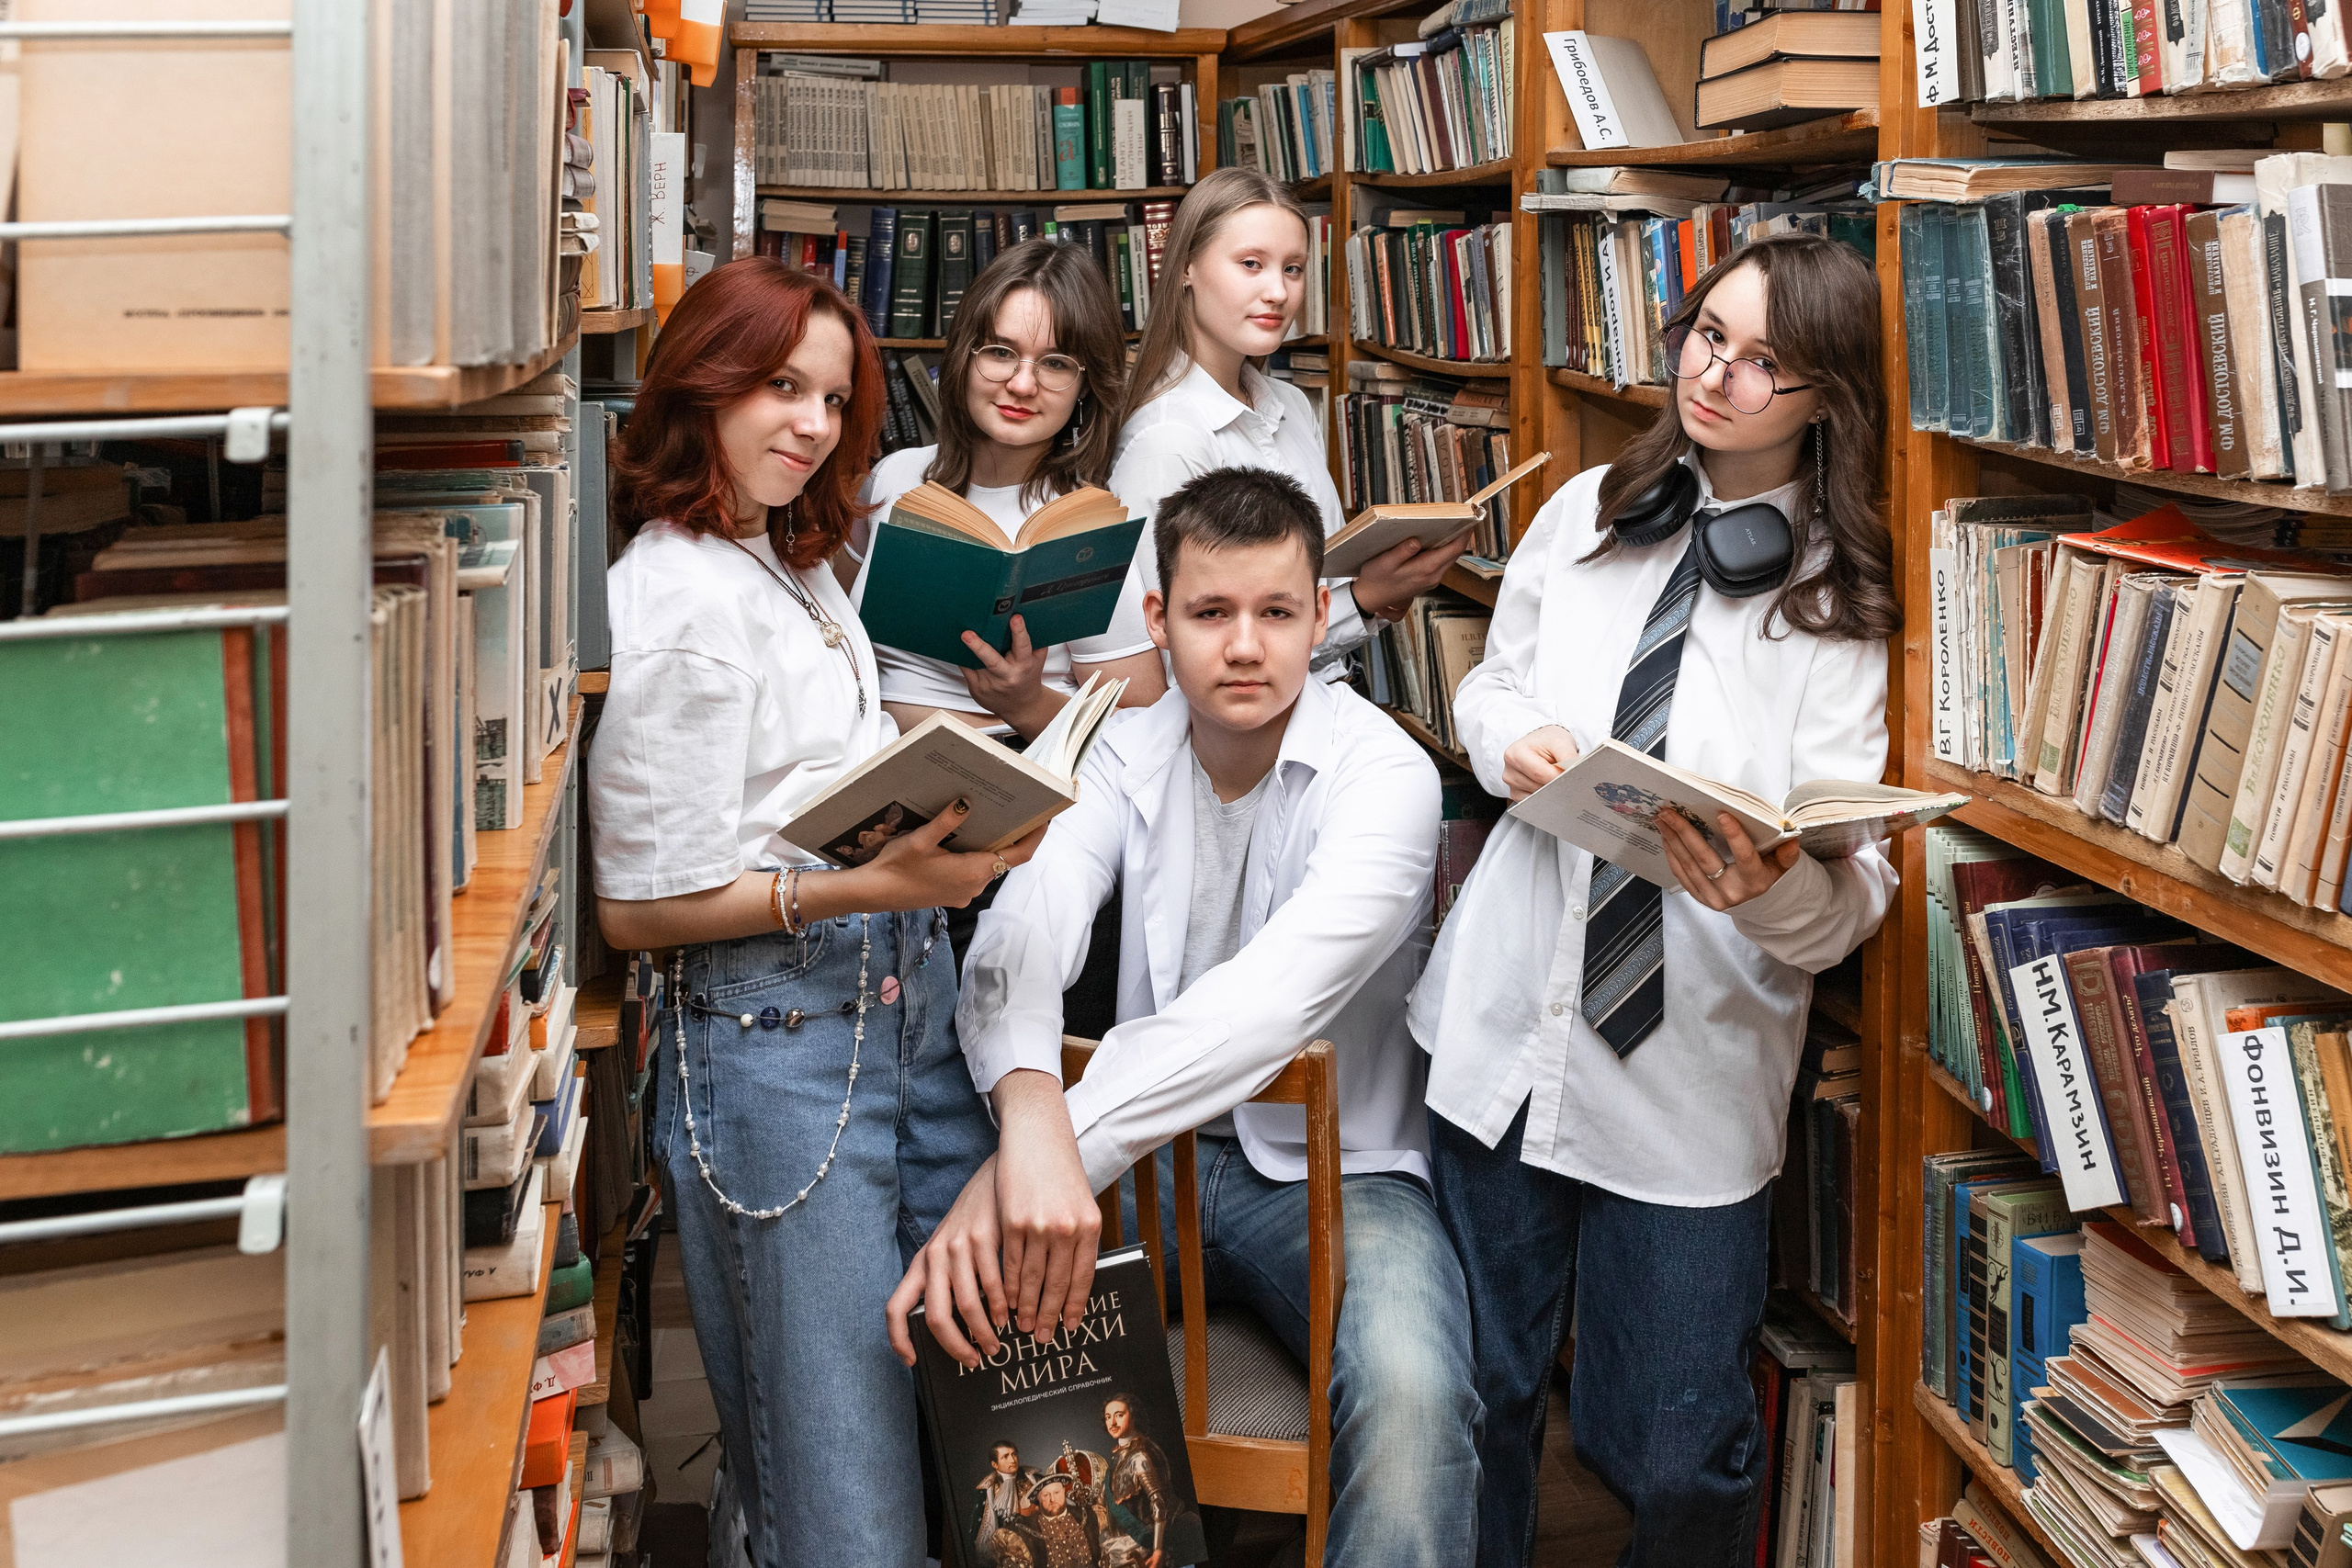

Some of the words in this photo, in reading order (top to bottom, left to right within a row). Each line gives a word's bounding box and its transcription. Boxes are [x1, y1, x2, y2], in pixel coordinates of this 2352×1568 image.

[2007, 0, 2019, 72] ПРЕСТУПЛ
[1564, 38, 1600, 113] Грибоедов
[1594, 114, 1612, 141] А.С.
[1925, 58, 1938, 78] М.
[1925, 81, 1939, 103] Ф.
[651, 162, 667, 201] ВЕРН
[2268, 231, 2281, 283] НАКАЗАНИЕ
[2161, 251, 2175, 327] ДОСТОЕВСКИЙ
[2086, 306, 2108, 406] ДОСТОЕВСКИЙ
[2209, 312, 2233, 420] ДОСТОЕВСКИЙ
[2310, 317, 2327, 384] Чернышевский
[1437, 429, 1453, 502] ОГОЛЬ
[2149, 708, 2163, 746] РАССКАЗЫ
[2247, 646, 2288, 770] КОРОЛЕНКО
[2280, 750, 2297, 792] РАССКАЗЫ
[2123, 995, 2141, 1035] делать?
[2131, 1036, 2142, 1059] Что
[2188, 1026, 2203, 1072] КРЫЛОВ
[2142, 1077, 2165, 1159] Чернышевский
[2245, 1034, 2290, 1214] ФОНВИЗИН
[990, 1387, 1069, 1412] ЭНЦИКЛОПЕДИЧЕСКИЙ
[1068, 1376, 1113, 1393] СПРАВОЧНИК
[1001, 1350, 1099, 1395] МИРА
[1968, 1517, 2011, 1563] ПОВЕСТИ
